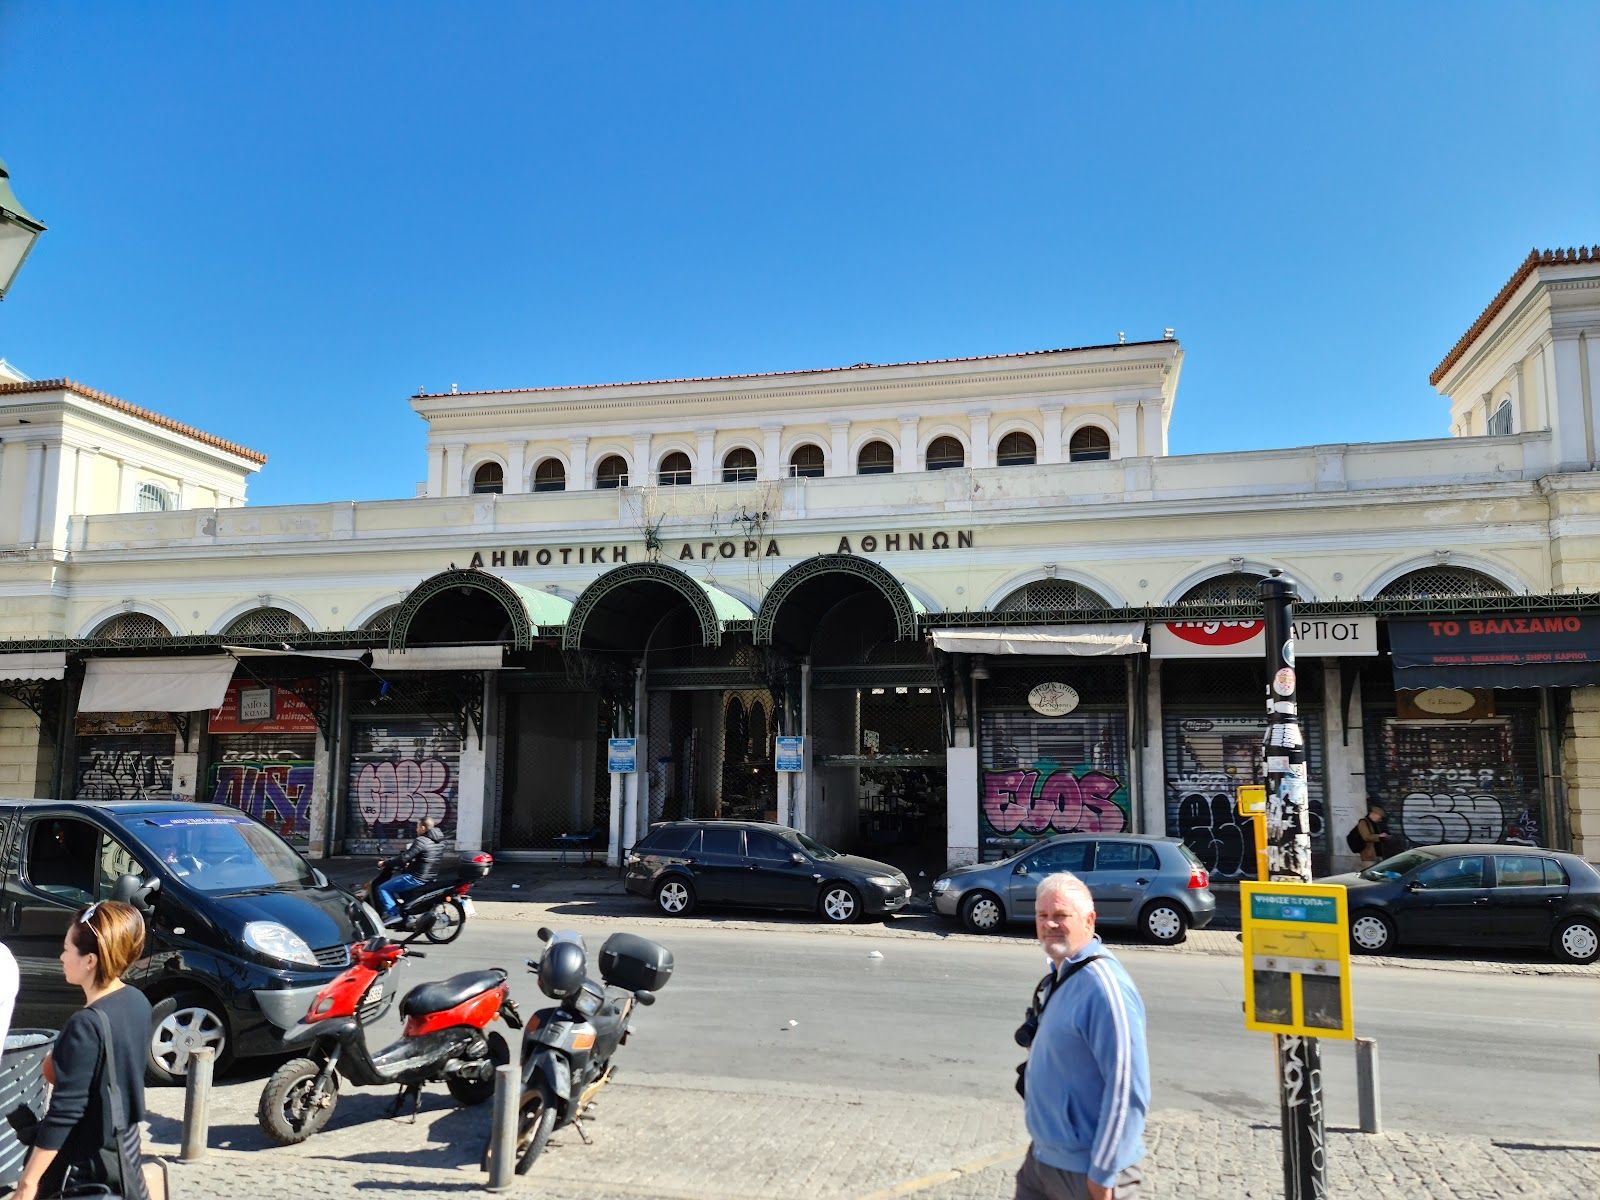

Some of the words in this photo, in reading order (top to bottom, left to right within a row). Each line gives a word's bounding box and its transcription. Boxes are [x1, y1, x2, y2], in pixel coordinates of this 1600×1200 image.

[470, 546, 627, 567] ΔΗΜΟΤΙΚΗ
[679, 539, 780, 560] ΑΓΟΡΑ
[837, 530, 973, 554] ΑΘΗΝΩΝ
[1291, 621, 1359, 640] ΑΡΠΟΙ
[1429, 621, 1460, 637] ΤΟ
[1469, 616, 1582, 636] ΒΑΛΣΑΜΟ
[1554, 652, 1588, 661] ΚΑΡΠΟΙ
[983, 769, 1128, 836] ELOS
